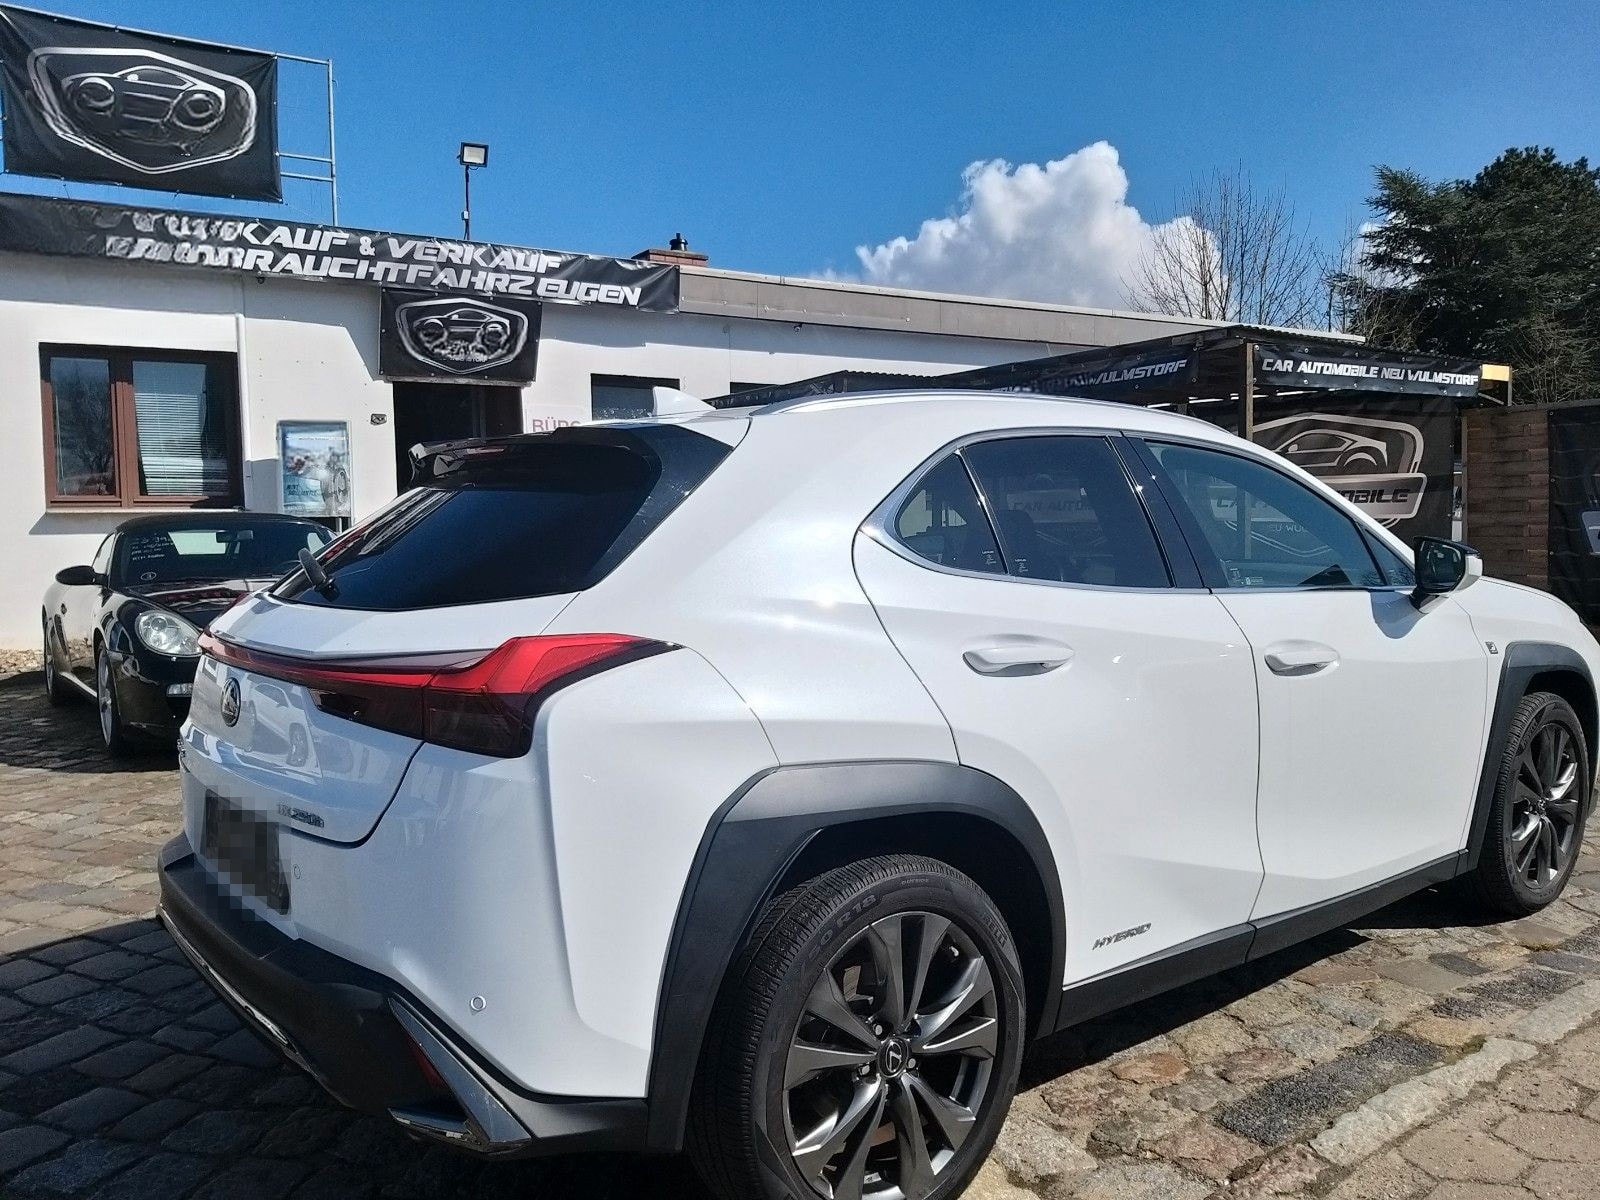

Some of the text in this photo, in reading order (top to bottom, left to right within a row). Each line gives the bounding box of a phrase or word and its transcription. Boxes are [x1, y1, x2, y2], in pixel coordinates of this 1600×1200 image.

[359, 236, 376, 256] &
[388, 238, 562, 273] VERKAUF
[1262, 358, 1479, 386] CAR AUTOMOBILE NEU WULMSTORF
[1092, 923, 1152, 950] HYBRID
